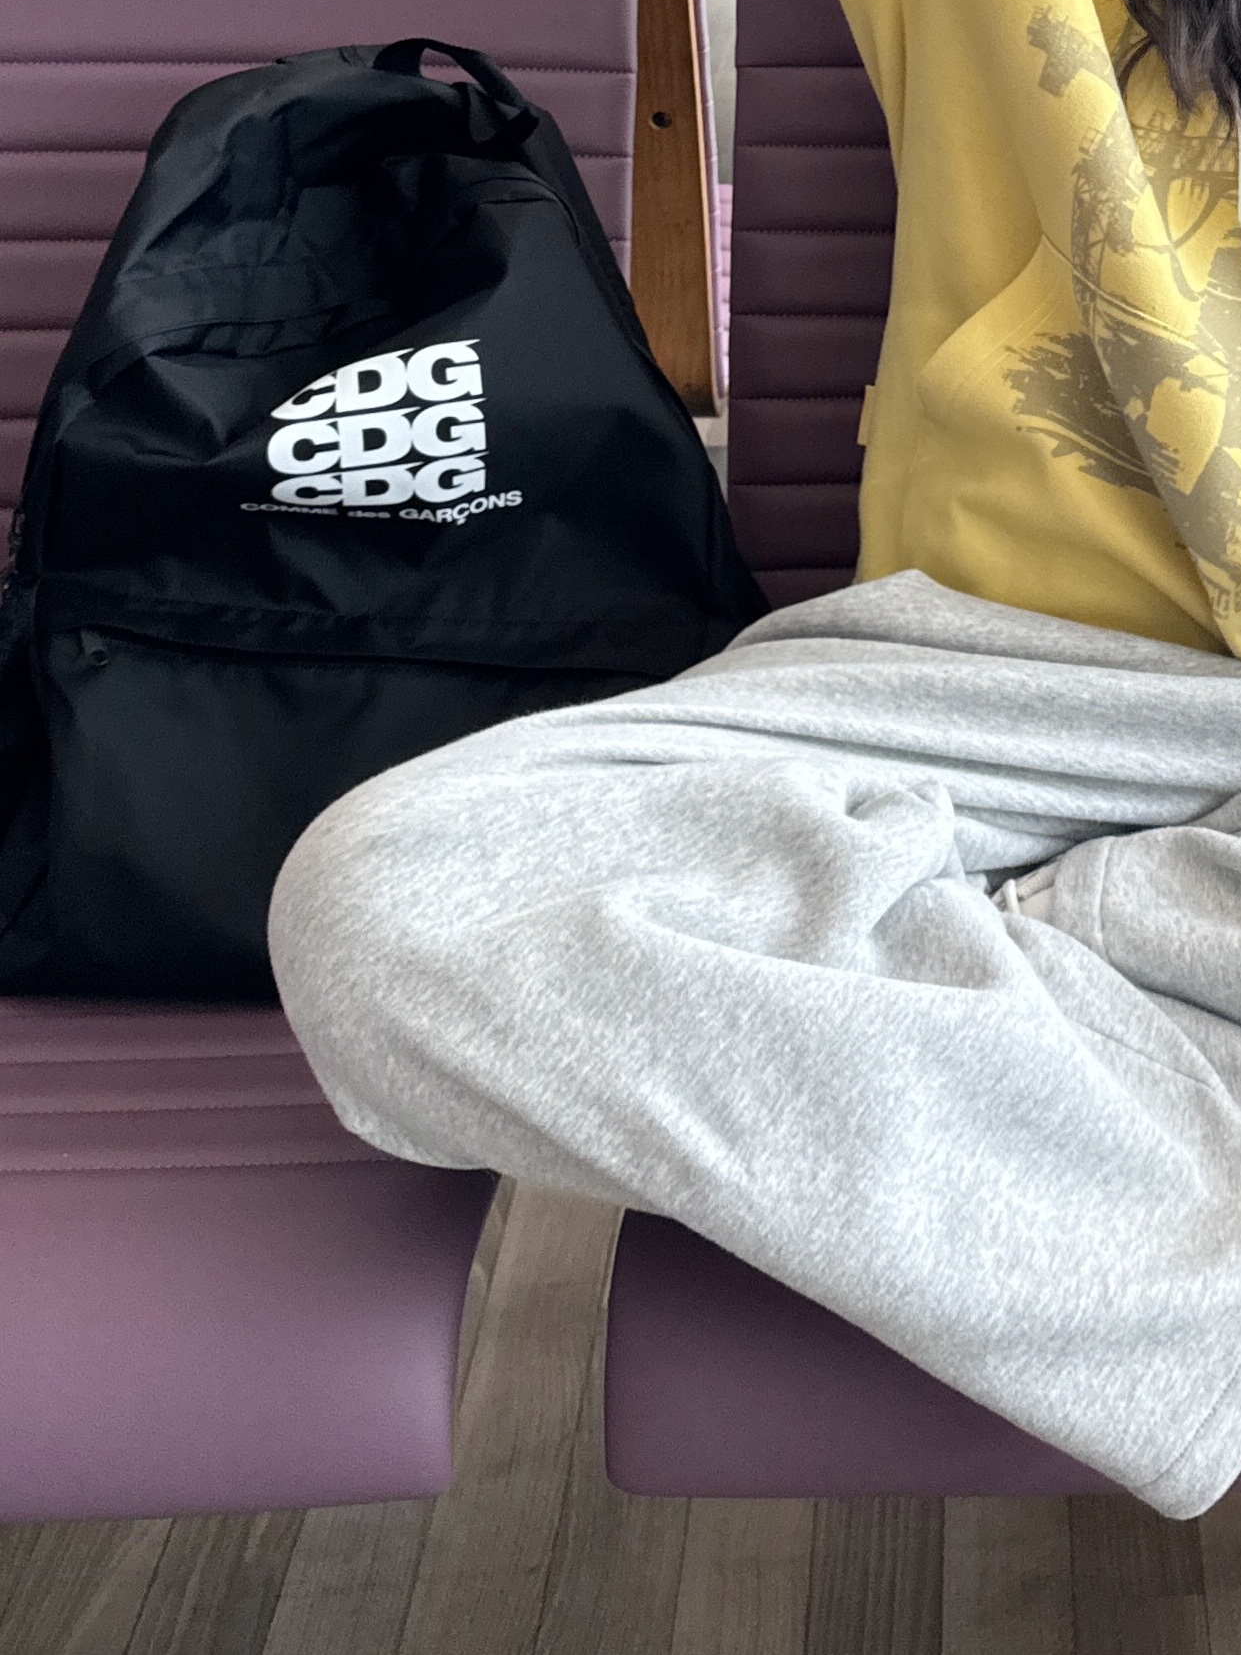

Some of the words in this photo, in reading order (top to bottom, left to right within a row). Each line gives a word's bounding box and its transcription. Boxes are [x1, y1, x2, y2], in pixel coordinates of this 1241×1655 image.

[270, 339, 483, 420] CDG
[267, 398, 487, 474] CDG
[240, 502, 339, 517] COMME
[347, 510, 391, 519] des
[399, 490, 523, 525] GARÇONS
[271, 451, 489, 506] CDG
